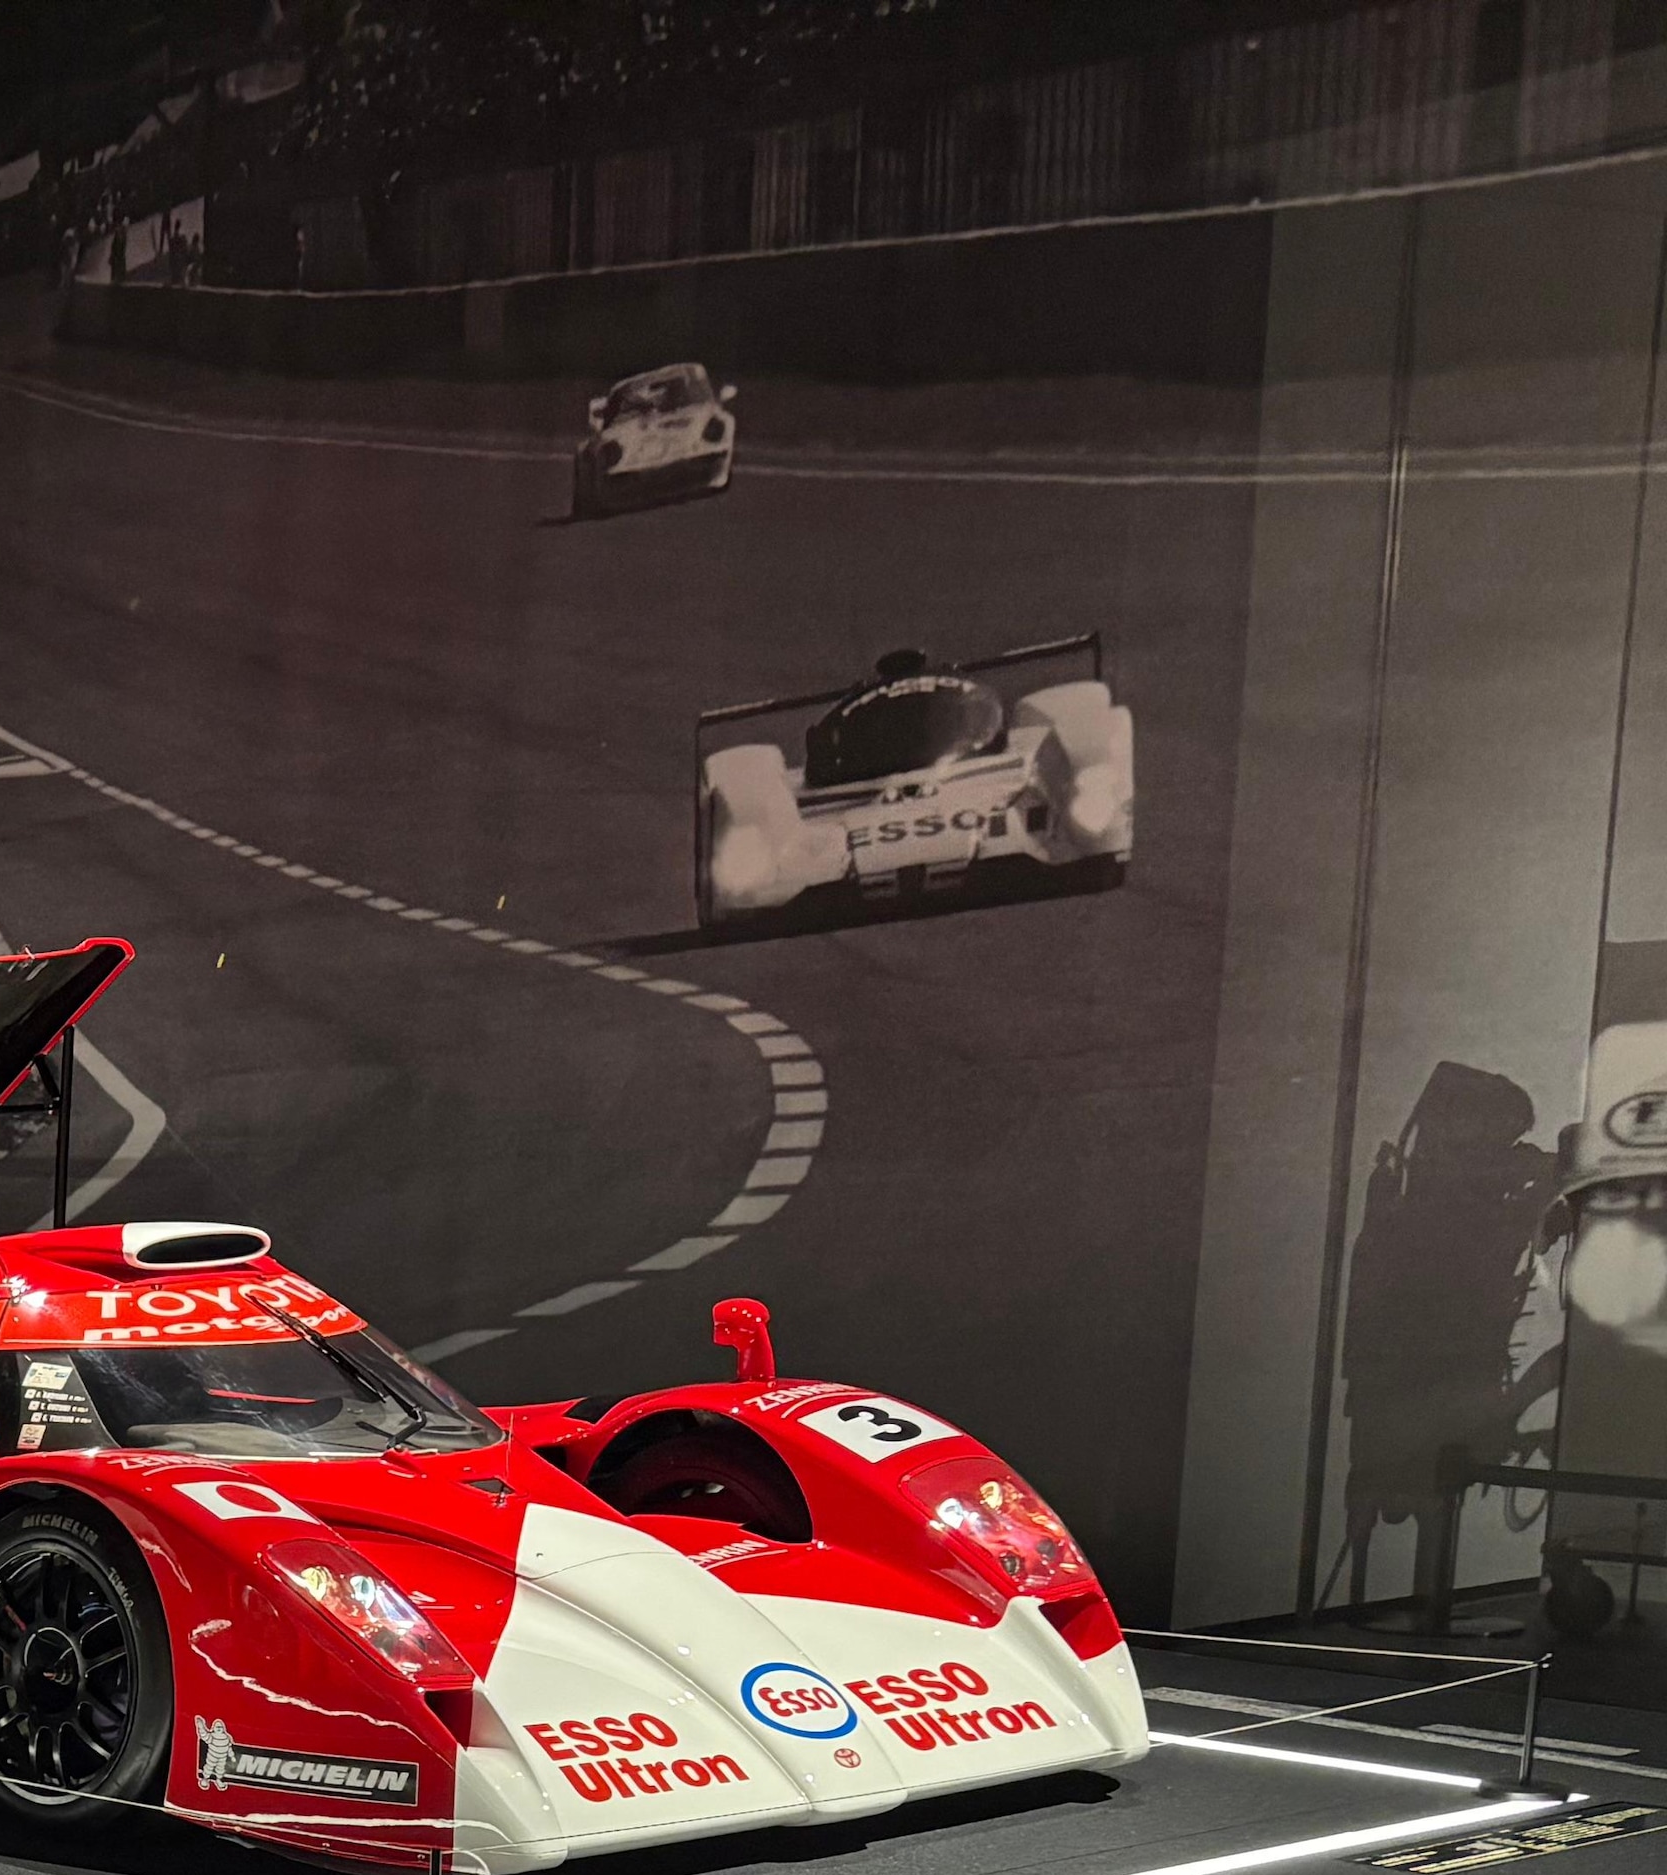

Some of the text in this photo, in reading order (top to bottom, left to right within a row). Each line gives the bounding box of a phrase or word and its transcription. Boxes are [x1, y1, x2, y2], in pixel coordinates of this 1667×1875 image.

[847, 808, 984, 851] ESSO
[85, 1274, 324, 1319] TOYOTA
[838, 1405, 922, 1442] 3
[22, 1514, 99, 1546] MICHELIN
[842, 1662, 988, 1716] ESSO
[523, 1712, 678, 1761] ESSO
[883, 1701, 1057, 1751] Ultron
[236, 1754, 409, 1792] MICHELIN
[559, 1751, 750, 1803] Ultron
